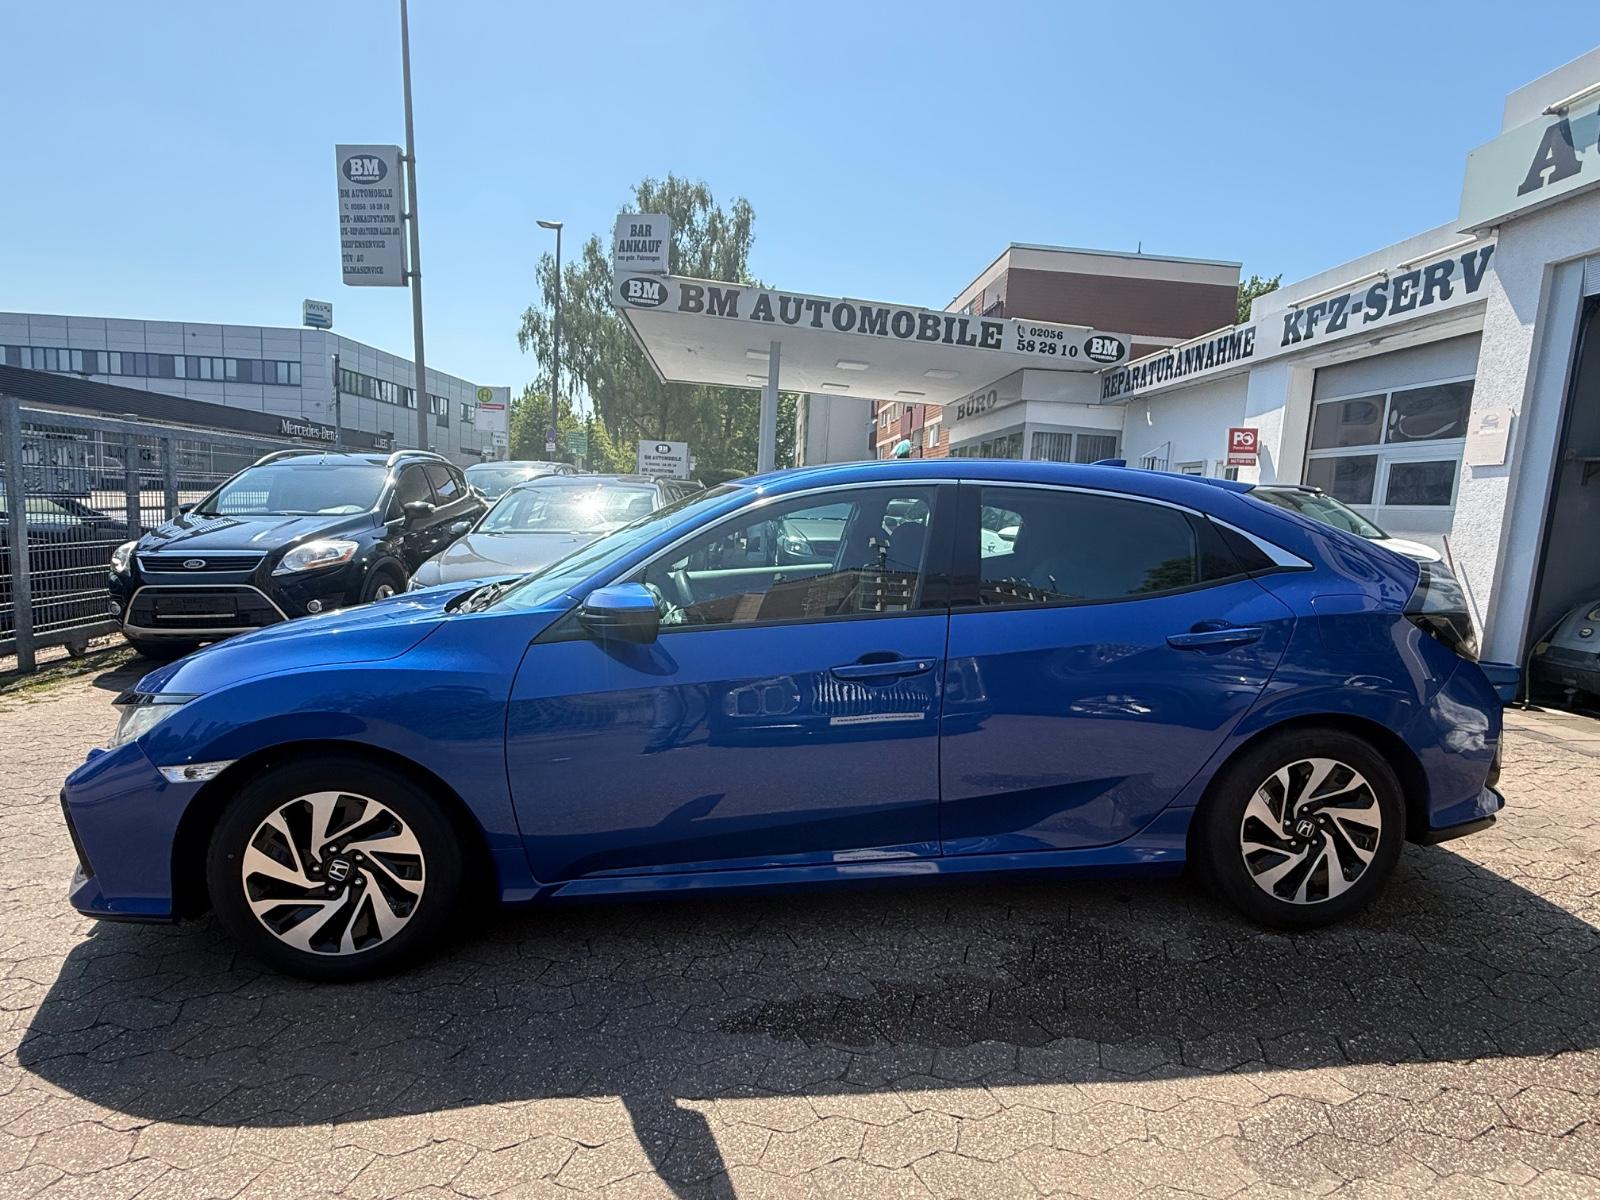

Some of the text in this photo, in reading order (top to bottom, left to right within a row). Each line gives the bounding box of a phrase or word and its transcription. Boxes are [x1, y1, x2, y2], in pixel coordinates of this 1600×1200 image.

[1517, 104, 1600, 197] A
[350, 159, 379, 175] BM
[340, 189, 393, 198] BM AUTOMOBILE
[630, 224, 652, 237] BAR
[618, 240, 662, 253] ANKAUF
[343, 266, 384, 275] KLIMASERVICE
[628, 280, 660, 299] BM
[678, 283, 1004, 350] BM AUTOMOBILE
[1030, 328, 1064, 340] 02056
[1017, 339, 1078, 357] 58 28 10
[1090, 338, 1120, 356] BM
[1102, 325, 1257, 399] REPARATURANNAHME
[956, 389, 998, 421] BÜRO
